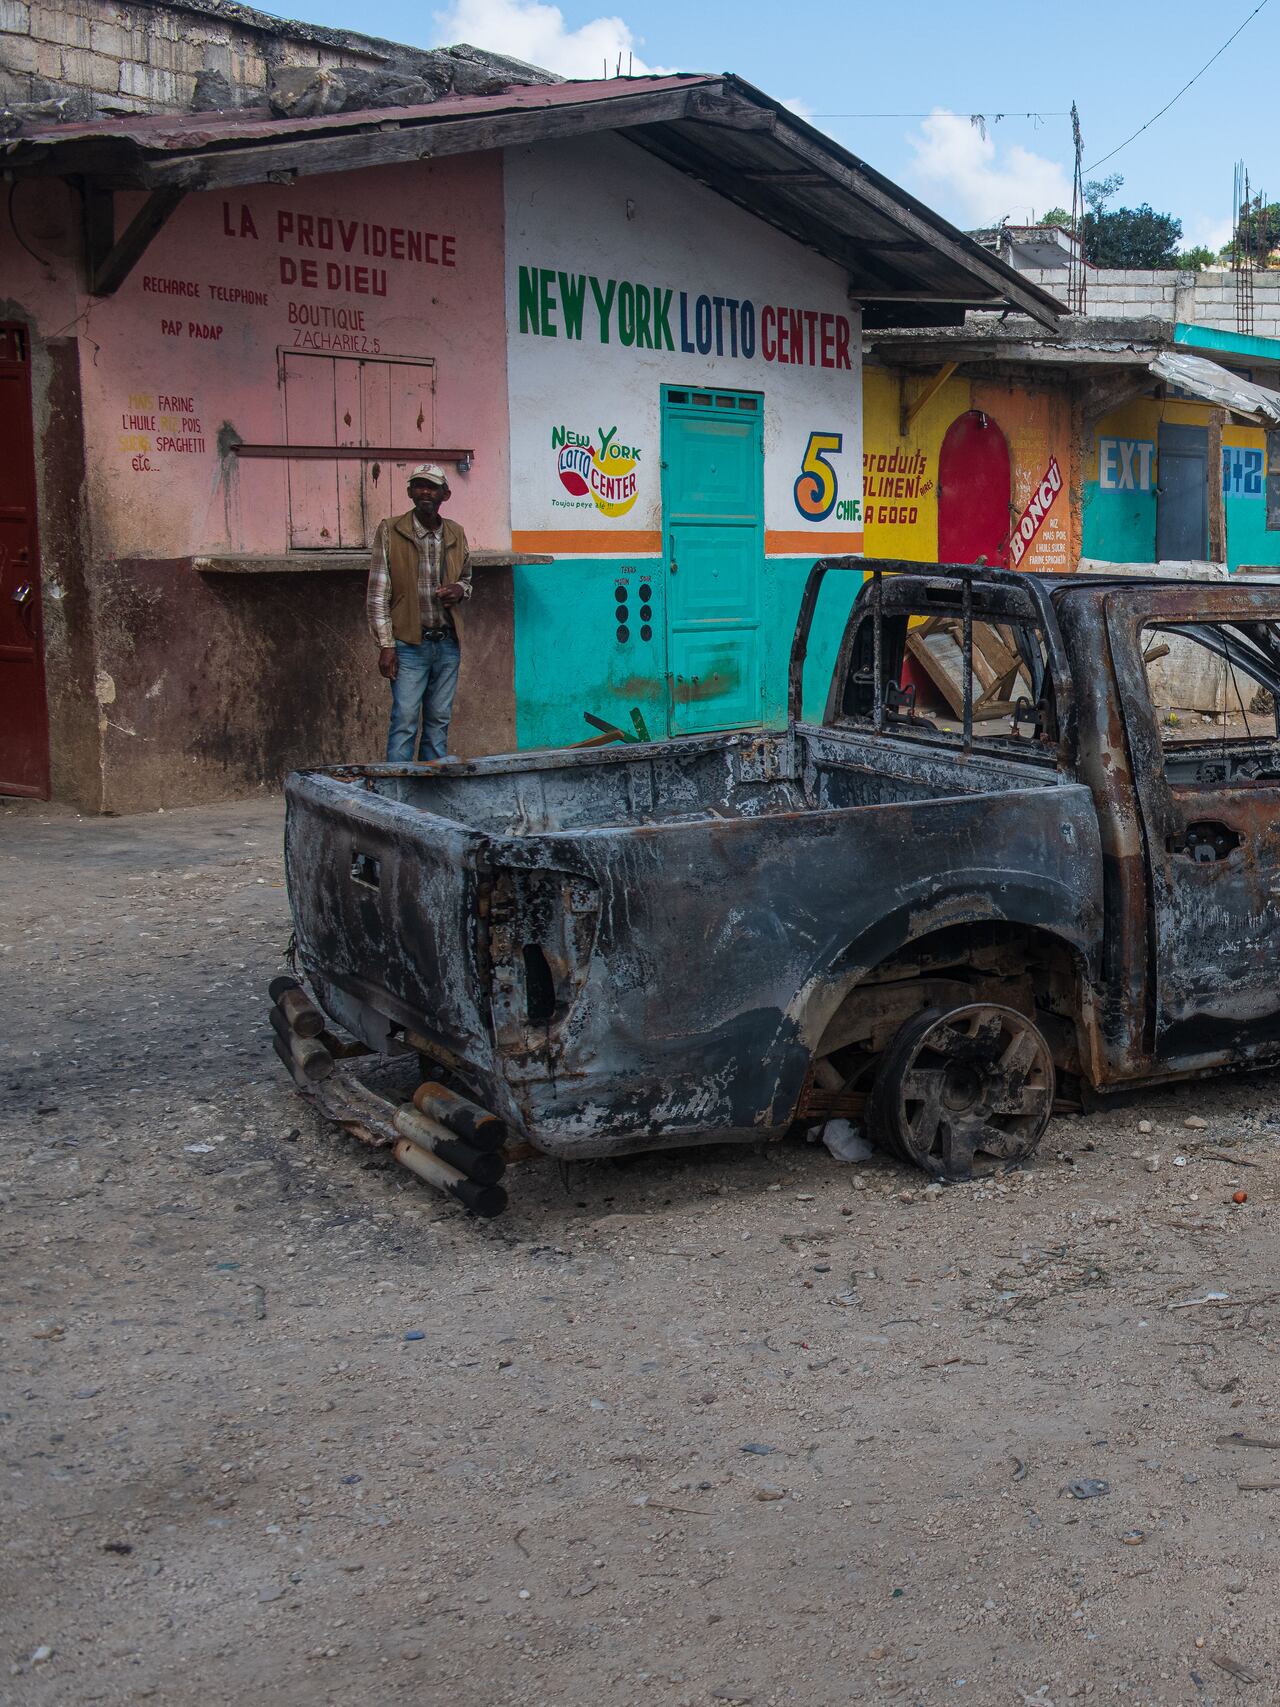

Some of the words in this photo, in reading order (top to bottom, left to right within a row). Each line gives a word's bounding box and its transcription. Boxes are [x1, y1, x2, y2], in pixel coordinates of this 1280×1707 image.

[222, 201, 259, 240] LA
[277, 210, 456, 267] PROVIDENCE
[143, 275, 200, 298] RECHARGE
[208, 285, 269, 306] TELEPHONE
[279, 256, 318, 288] DE
[327, 262, 388, 297] DIEU
[161, 319, 183, 337] PAP
[188, 322, 224, 341] PADAP
[288, 302, 366, 332] BOUTIQUE
[518, 265, 586, 341] NEW
[589, 275, 675, 351] YORK
[680, 291, 756, 360] LOTTO
[761, 304, 852, 370] CENTER
[158, 395, 194, 413] FARINE
[156, 437, 206, 453] SPAGHETTI
[560, 449, 591, 479] LOTTO
[794, 431, 843, 522] 5
[836, 500, 862, 521] CHIF.
[1100, 440, 1153, 490] EXT
[591, 468, 637, 500] CENTER
[552, 499, 574, 509] Toujou
[576, 501, 592, 509] peye
[864, 505, 874, 524] A
[878, 505, 918, 524] GOGO
